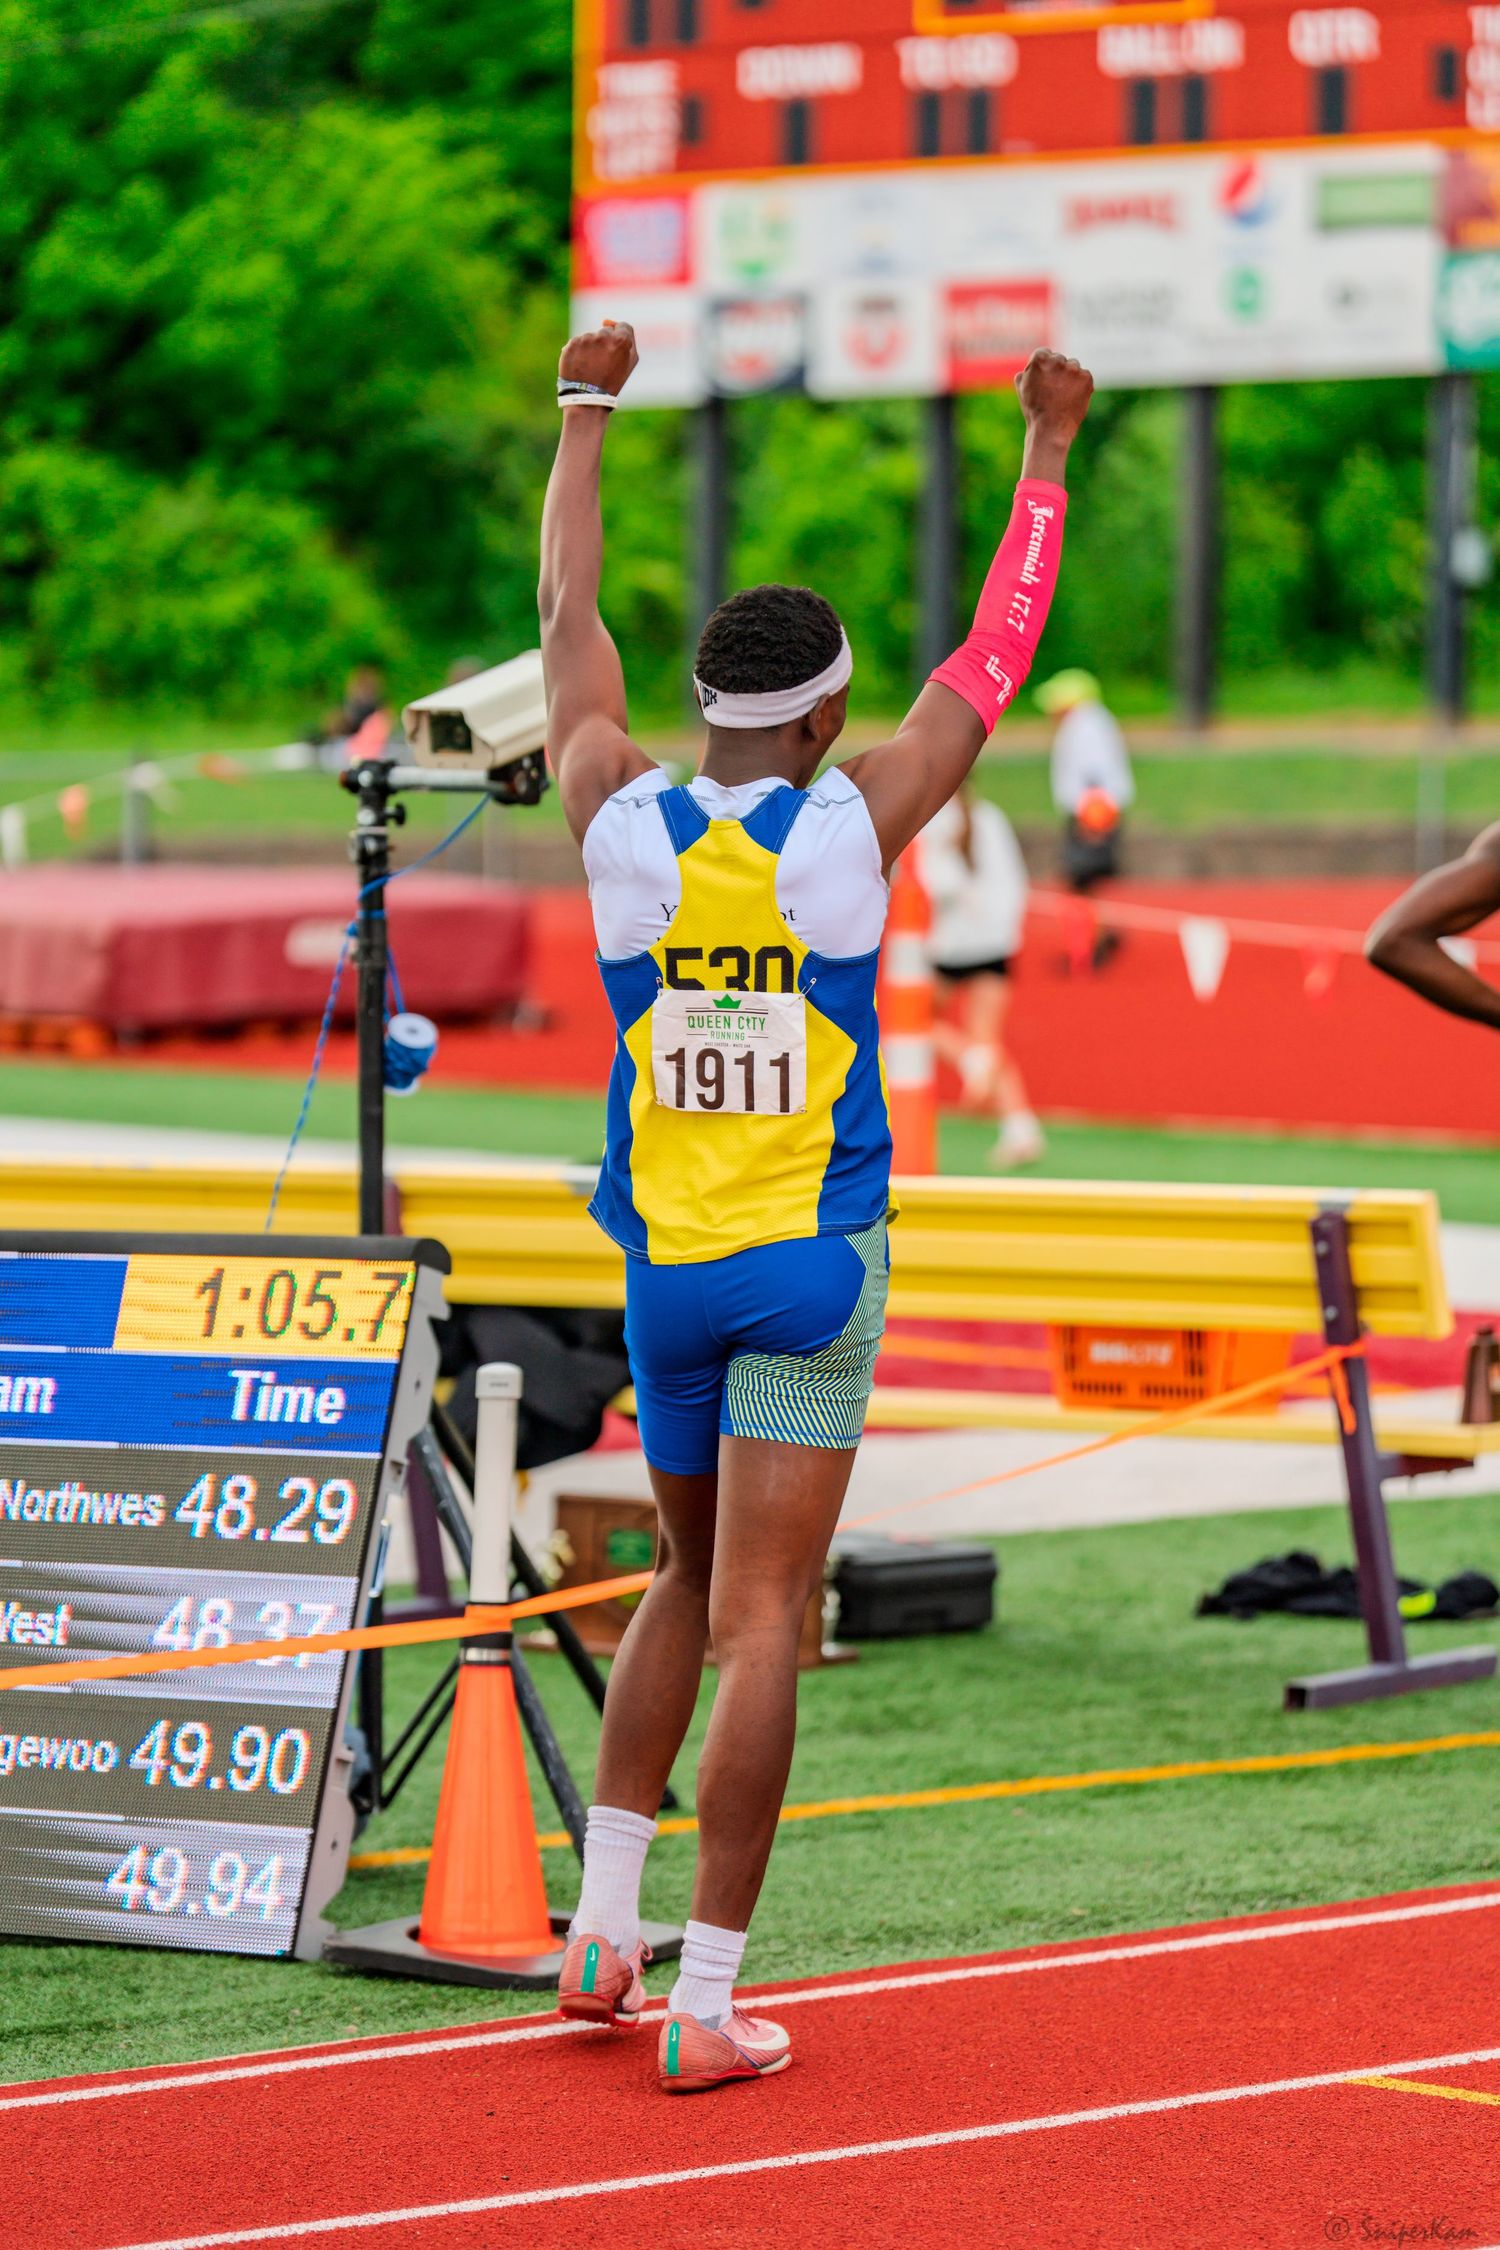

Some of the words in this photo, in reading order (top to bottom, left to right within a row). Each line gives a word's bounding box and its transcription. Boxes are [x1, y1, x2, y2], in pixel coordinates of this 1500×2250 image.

[1019, 500, 1054, 585] Jeremiah
[1007, 591, 1032, 634] 17:7
[665, 945, 794, 993] 530
[687, 1015, 731, 1029] QUEEN
[738, 1016, 765, 1031] CITY
[710, 1031, 746, 1041] RUNNING
[665, 1047, 790, 1113] 1911
[197, 1267, 412, 1342] 1:05.7
[229, 1370, 346, 1424] Time
[174, 1473, 358, 1544] 48.29
[129, 1720, 311, 1794] 49.90
[106, 1844, 284, 1920] 49.94
